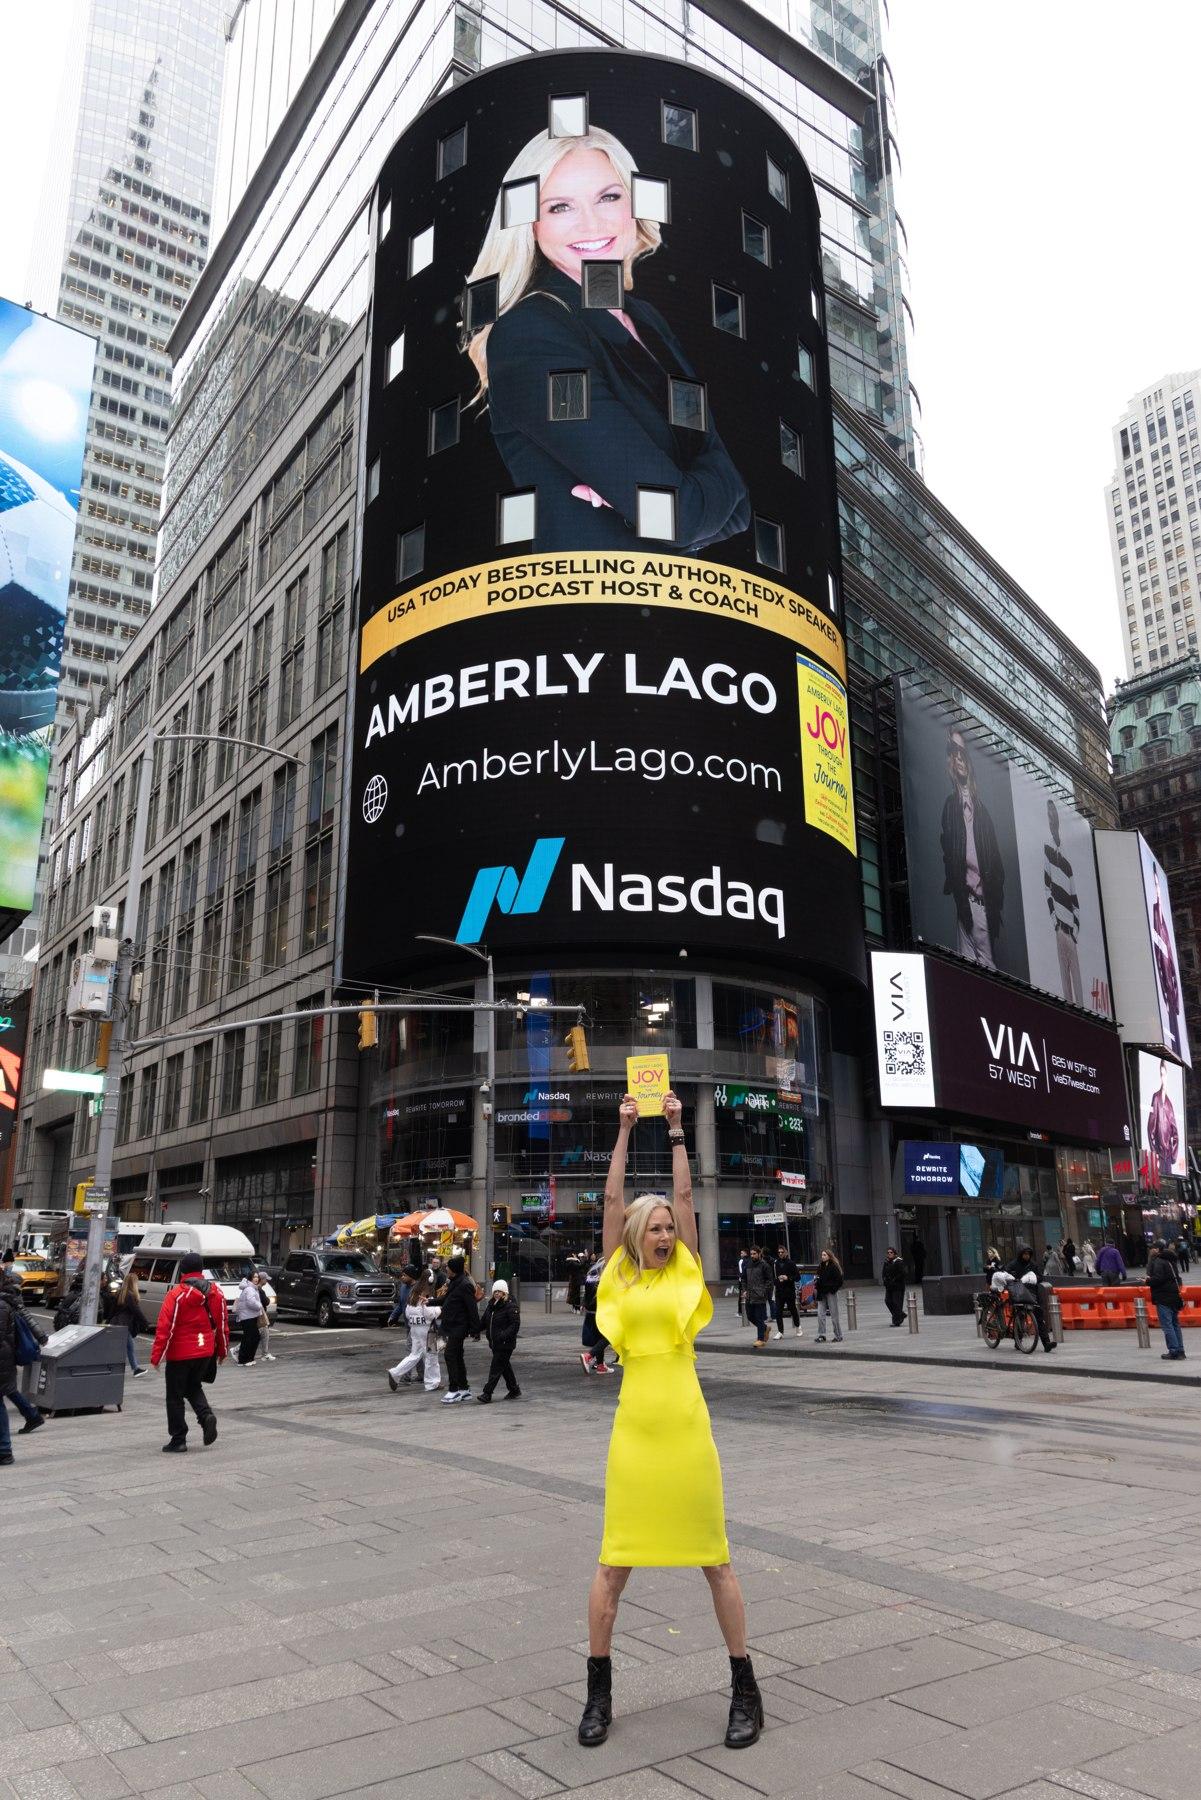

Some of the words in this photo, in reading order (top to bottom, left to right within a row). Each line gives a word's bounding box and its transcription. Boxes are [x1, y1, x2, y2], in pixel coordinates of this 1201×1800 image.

[387, 598, 416, 622] USA
[419, 572, 482, 606] TODAY
[487, 558, 635, 585] BESTSELLING
[642, 561, 737, 593] AUTHOR,
[741, 578, 785, 609] TEDX
[487, 580, 594, 606] PODCAST
[601, 580, 662, 598] HOST
[668, 585, 683, 601] &
[689, 588, 759, 618] COACH
[365, 653, 605, 749] AMBERLY
[625, 653, 777, 715] LAGO
[807, 685, 832, 707] AMBERLY
[807, 704, 845, 758] JOY
[417, 740, 782, 795] AmberlyLago.com
[571, 863, 786, 939] Nasdaq
[980, 1016, 1040, 1072] VIA
[632, 1069, 664, 1084] JOY
[988, 1063, 1004, 1080] 57
[1006, 1068, 1037, 1090] WEST
[1051, 1055, 1067, 1069] 625
[1067, 1060, 1074, 1071] W
[1089, 1067, 1097, 1078] ST
[1053, 1073, 1101, 1094] via57west.com
[405, 1103, 427, 1113] REWRITE
[429, 1099, 465, 1110] TOMORROW
[538, 1091, 570, 1102] Nasdaq
[586, 1092, 624, 1100] REWRITE
[910, 1175, 953, 1183] TOMORROW
[916, 1165, 948, 1173] REWRITE
